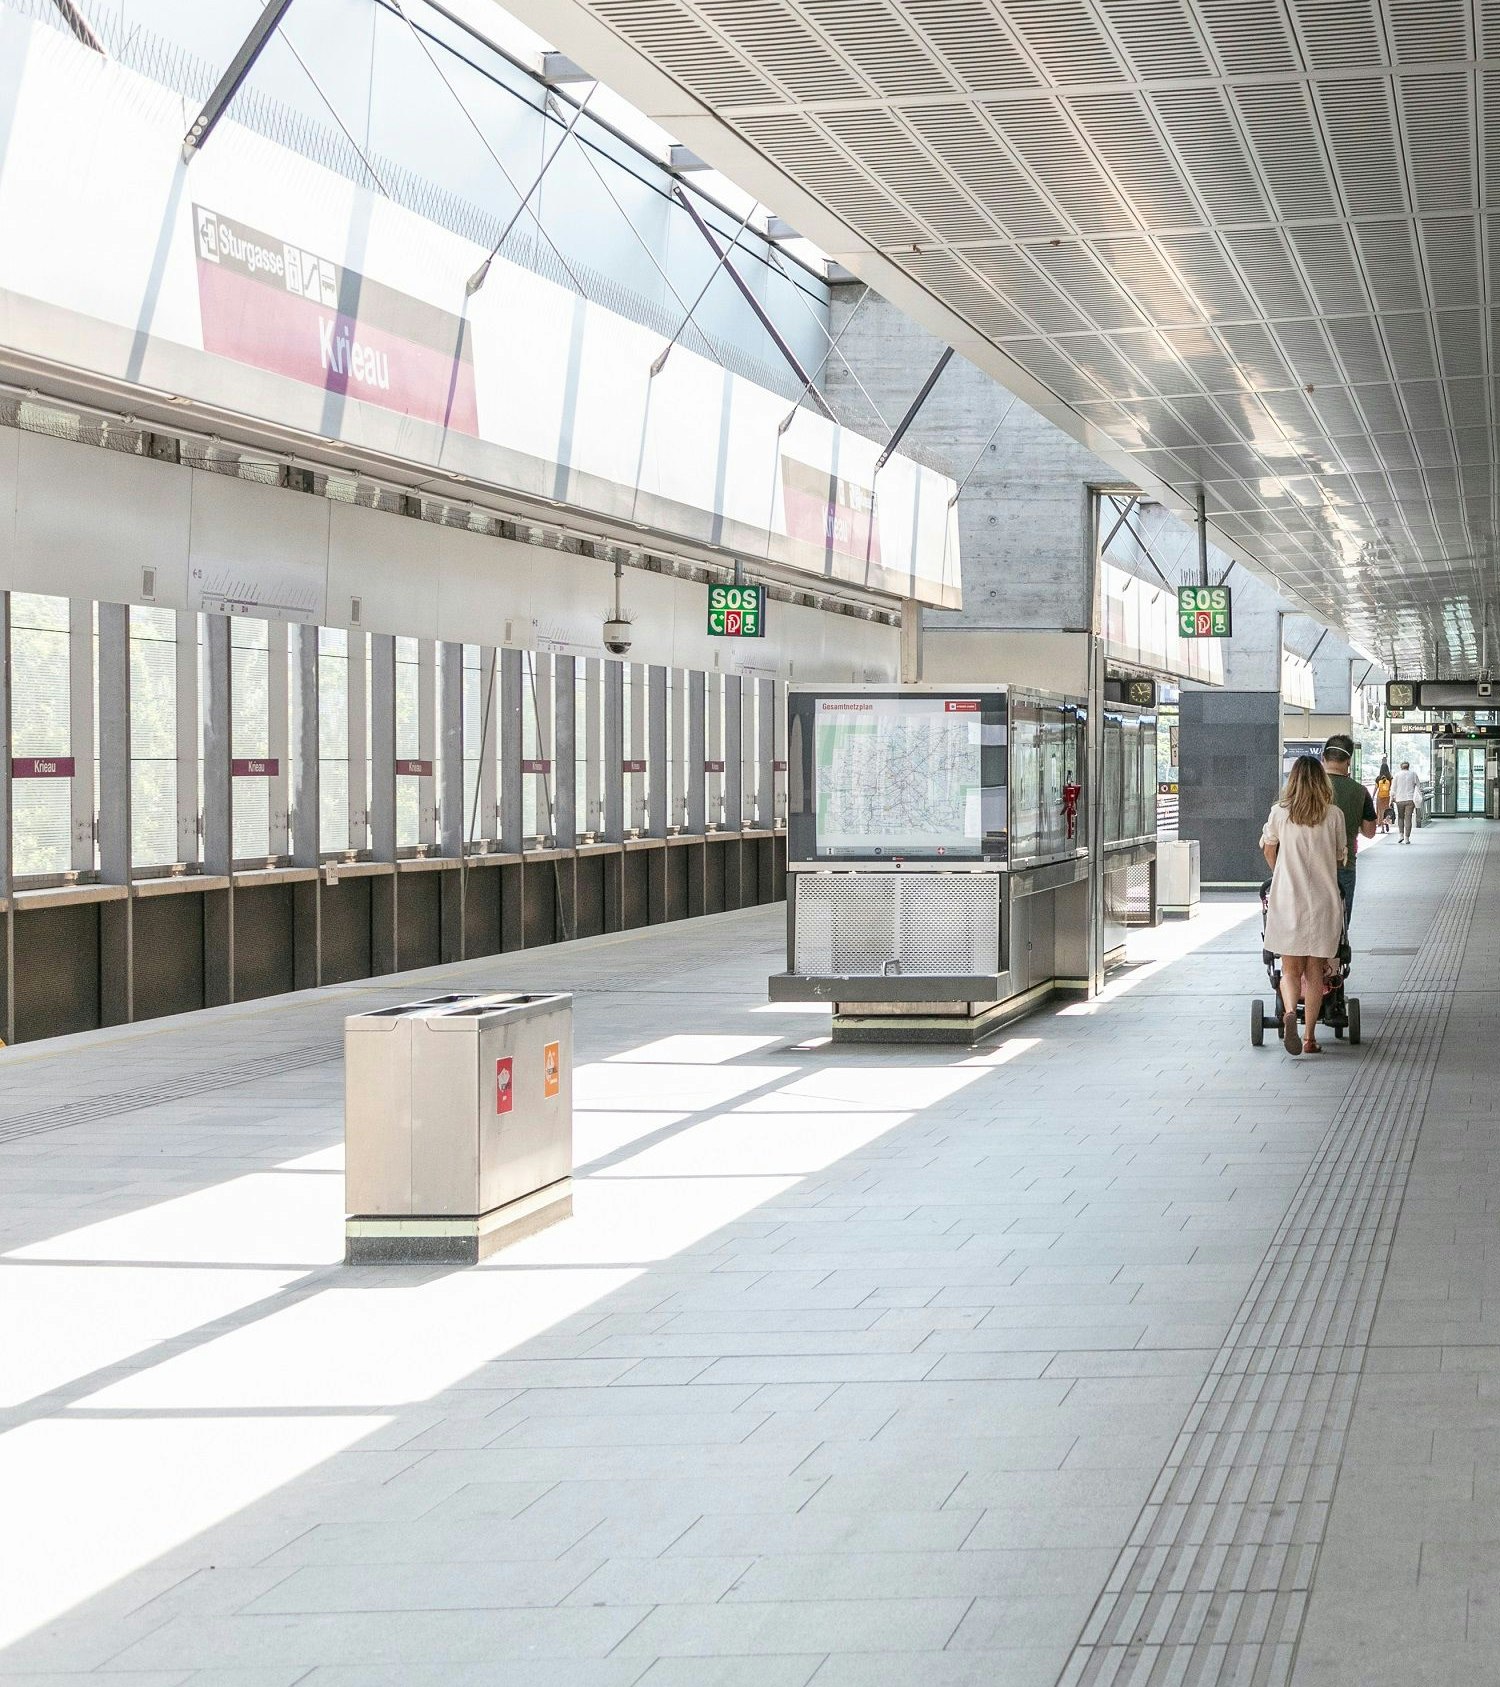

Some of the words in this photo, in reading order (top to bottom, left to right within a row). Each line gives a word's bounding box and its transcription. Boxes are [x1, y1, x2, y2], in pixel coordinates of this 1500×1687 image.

[219, 223, 284, 277] Sturgasse
[319, 315, 390, 390] Krieau
[711, 588, 757, 609] SOS
[1181, 590, 1226, 610] SOS
[822, 702, 873, 711] Gesamtnetzplan
[34, 760, 56, 774] Krieau
[248, 761, 265, 772] Krieau
[408, 761, 422, 773] Krieau
